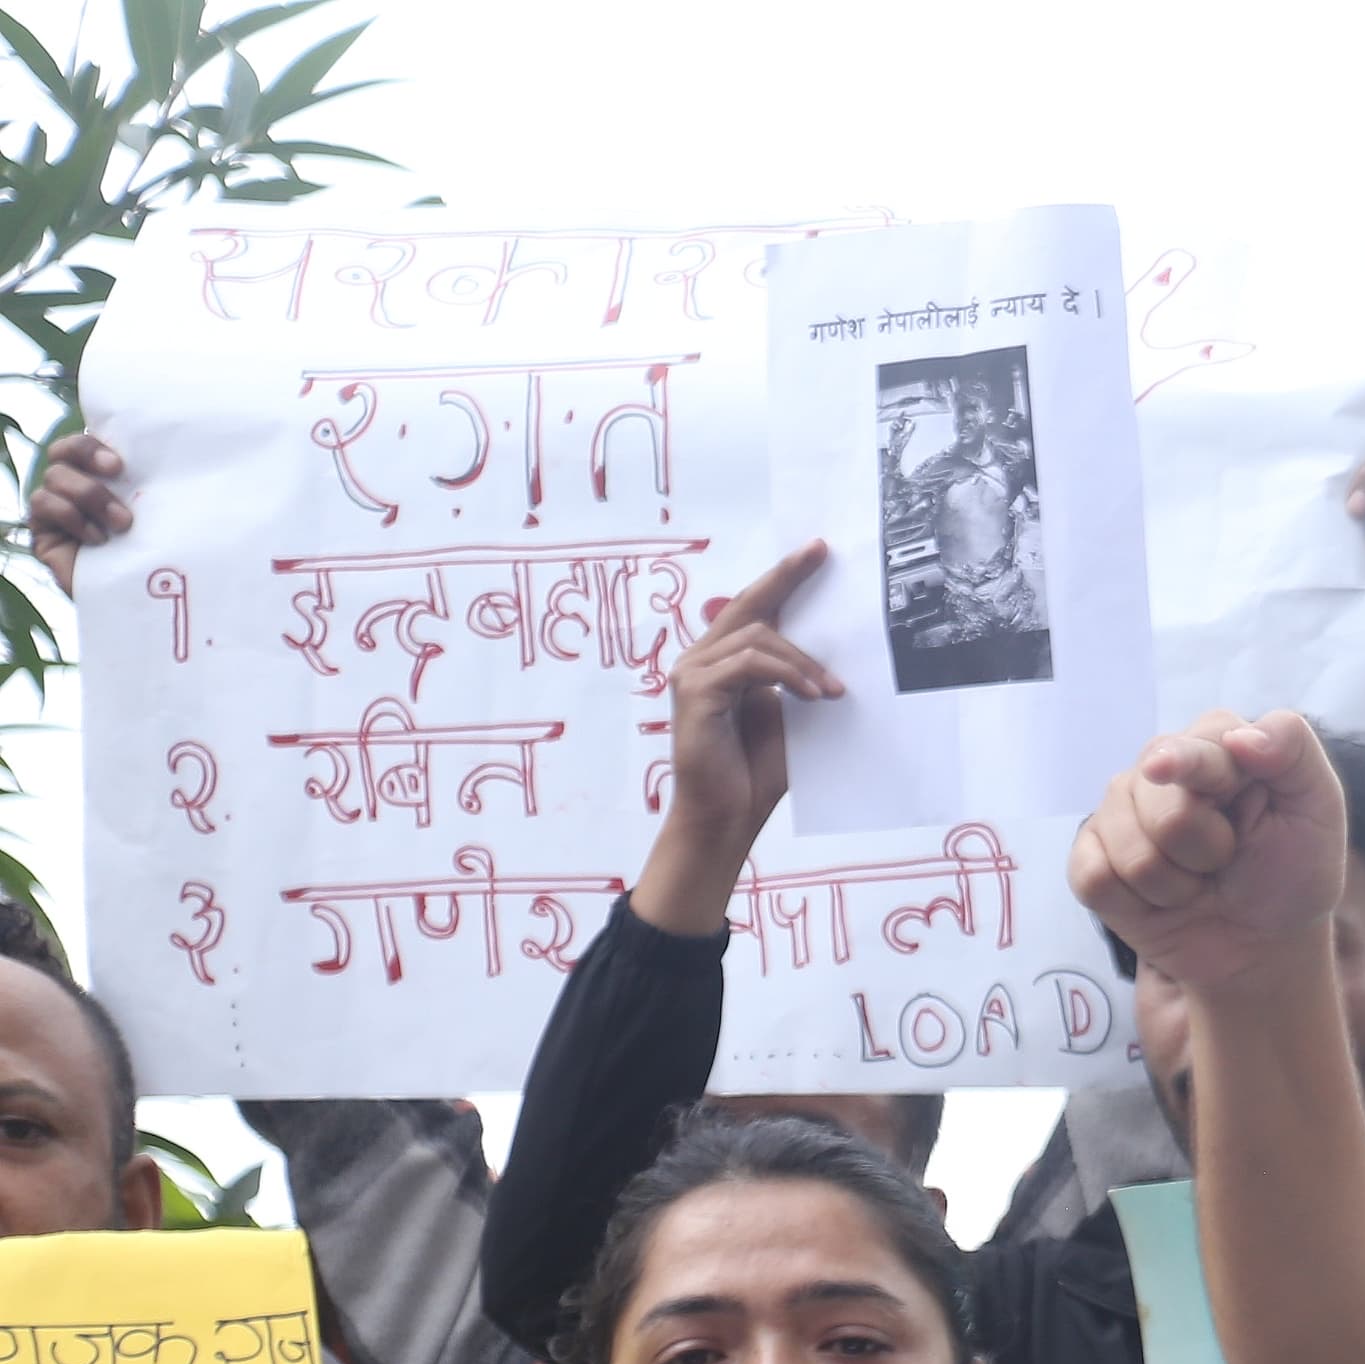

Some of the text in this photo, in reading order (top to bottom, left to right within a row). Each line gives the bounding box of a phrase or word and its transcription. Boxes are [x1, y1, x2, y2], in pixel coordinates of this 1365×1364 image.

[808, 314, 865, 343] गणेश
[991, 293, 1048, 318] न्याय
[1062, 285, 1080, 315] दे
[299, 353, 701, 526] रगत
[267, 696, 565, 828] रबिन
[850, 968, 1145, 1069] LOAD
